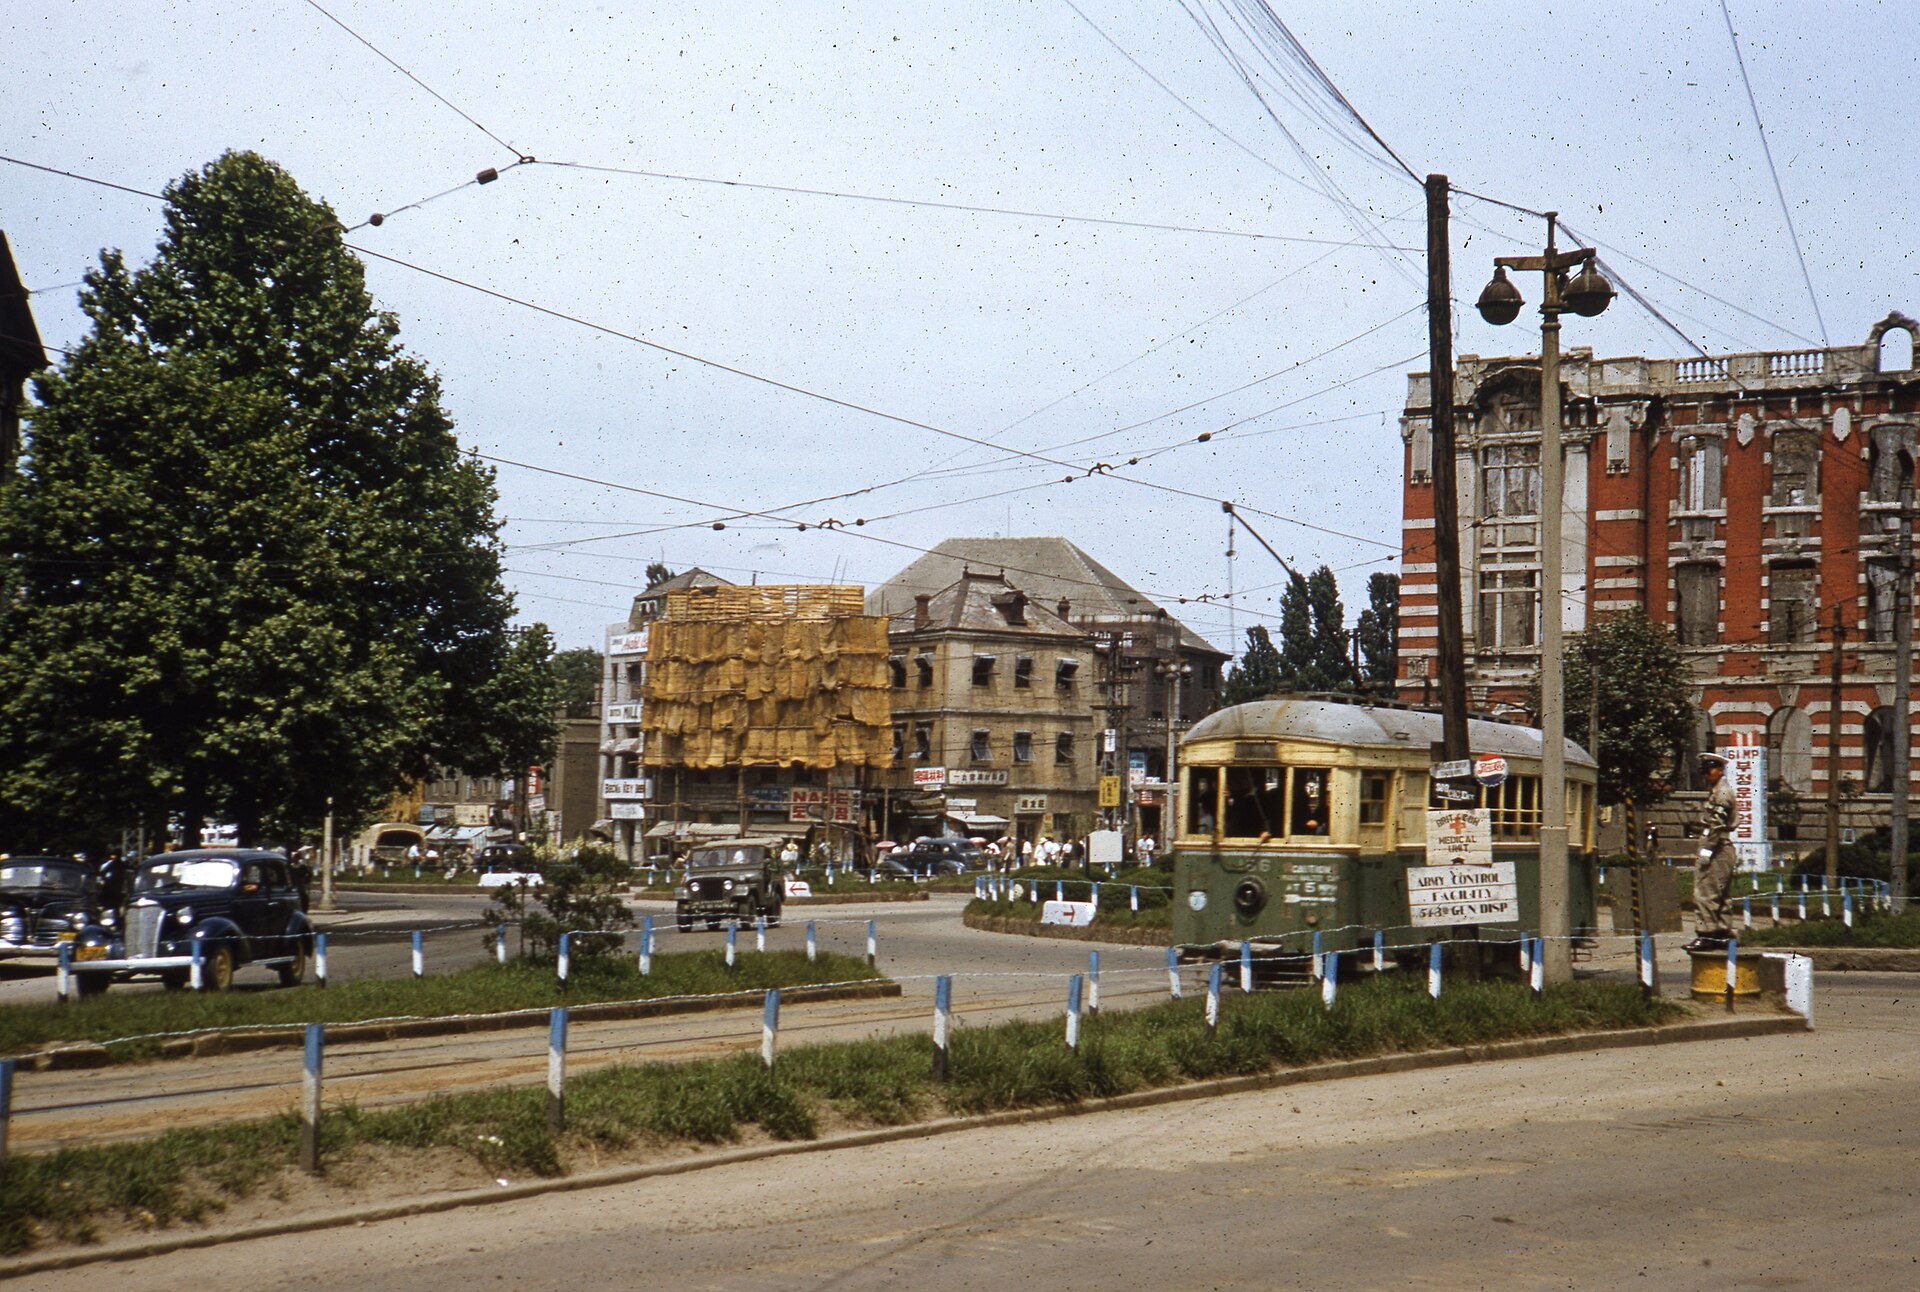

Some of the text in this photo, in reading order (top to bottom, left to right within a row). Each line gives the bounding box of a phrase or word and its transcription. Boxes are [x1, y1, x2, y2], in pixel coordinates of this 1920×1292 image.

[1439, 835, 1477, 845] MEDICAL
[1418, 873, 1500, 888] ARMY CONTROL
[1432, 889, 1492, 902] FACILITY
[1451, 905, 1477, 916] GEN
[1480, 903, 1508, 913] DISP
